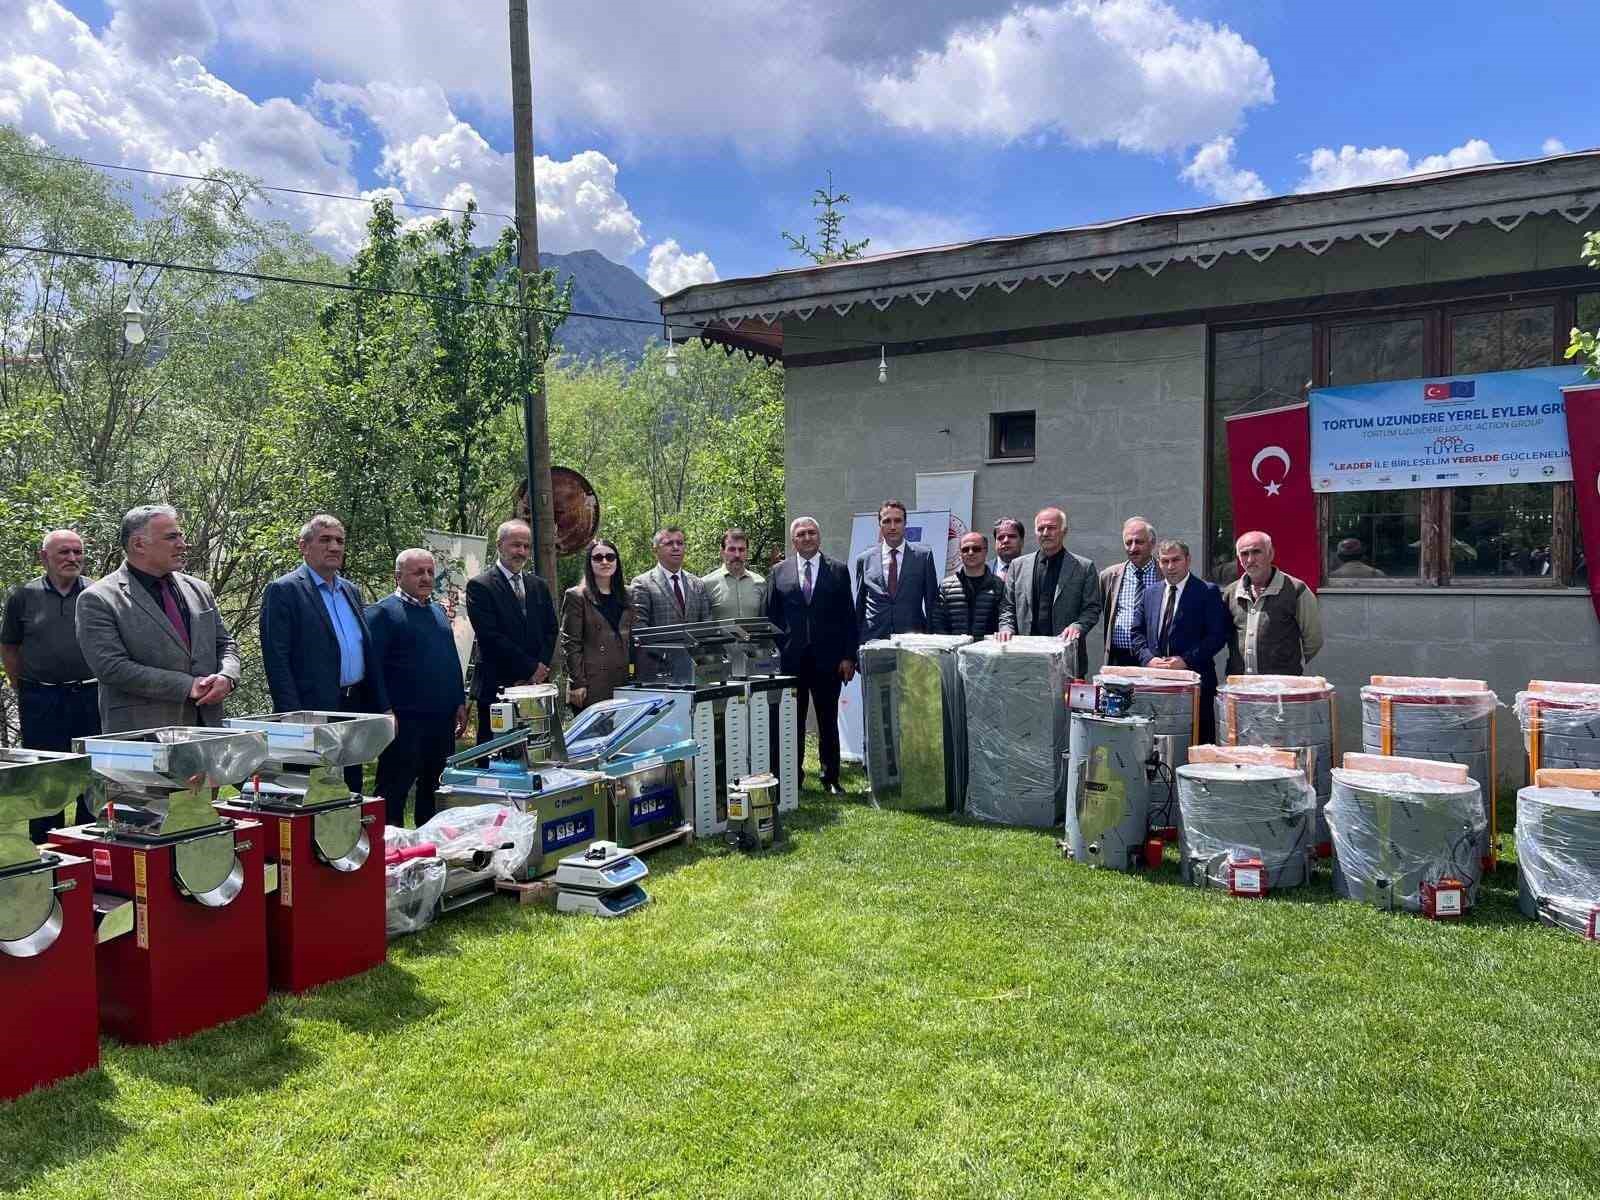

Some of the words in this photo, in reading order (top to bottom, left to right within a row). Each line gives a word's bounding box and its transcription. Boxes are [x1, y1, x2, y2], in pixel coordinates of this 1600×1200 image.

[1322, 417, 1374, 431] TORTUM
[1376, 412, 1446, 427] UZUNDERE
[1447, 409, 1489, 422] YEREL
[1492, 405, 1538, 419] EYLEM
[1475, 419, 1511, 431] ACTION
[1511, 418, 1544, 428] GROUP
[1452, 453, 1500, 464] YERELDE
